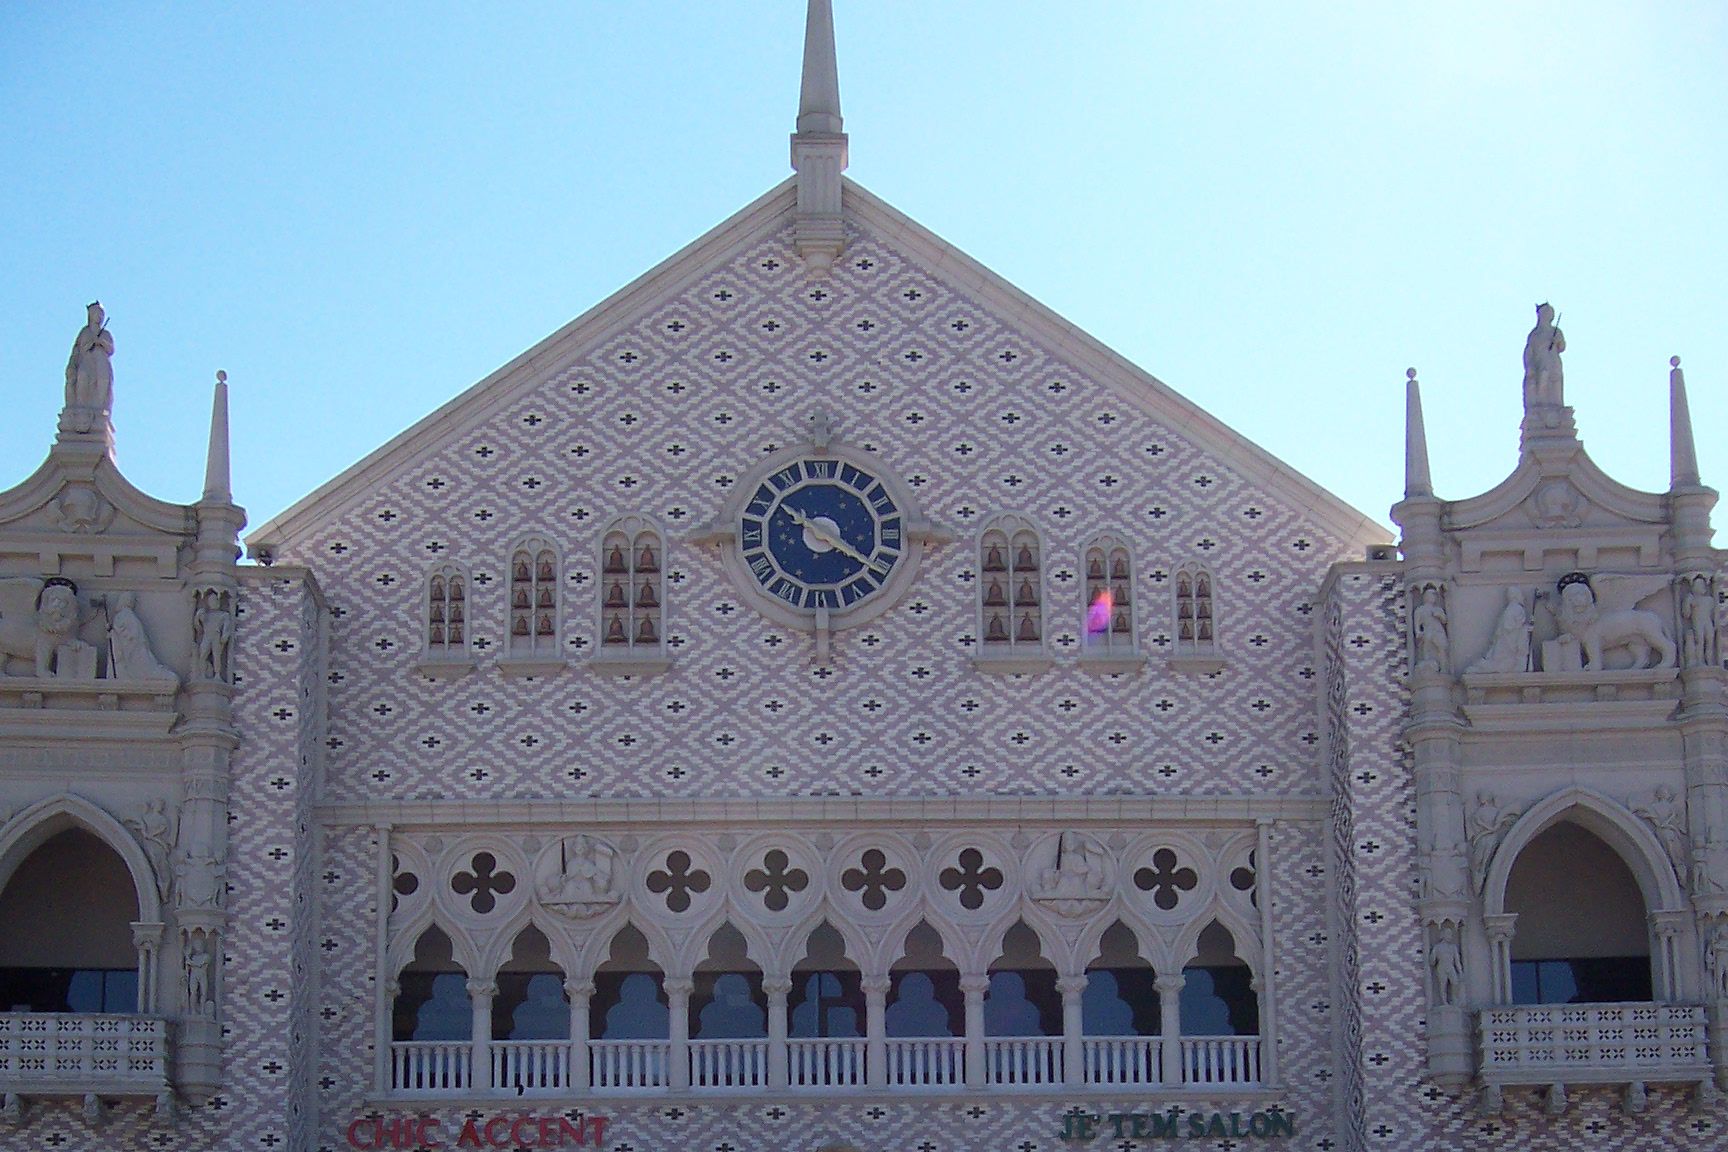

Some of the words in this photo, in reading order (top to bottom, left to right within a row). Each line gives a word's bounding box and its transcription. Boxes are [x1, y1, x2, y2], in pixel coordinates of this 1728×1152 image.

[347, 1118, 444, 1150] CHIC
[456, 1116, 609, 1149] ACCENT
[1108, 1112, 1179, 1139] TEM
[1188, 1111, 1297, 1139] SALON
